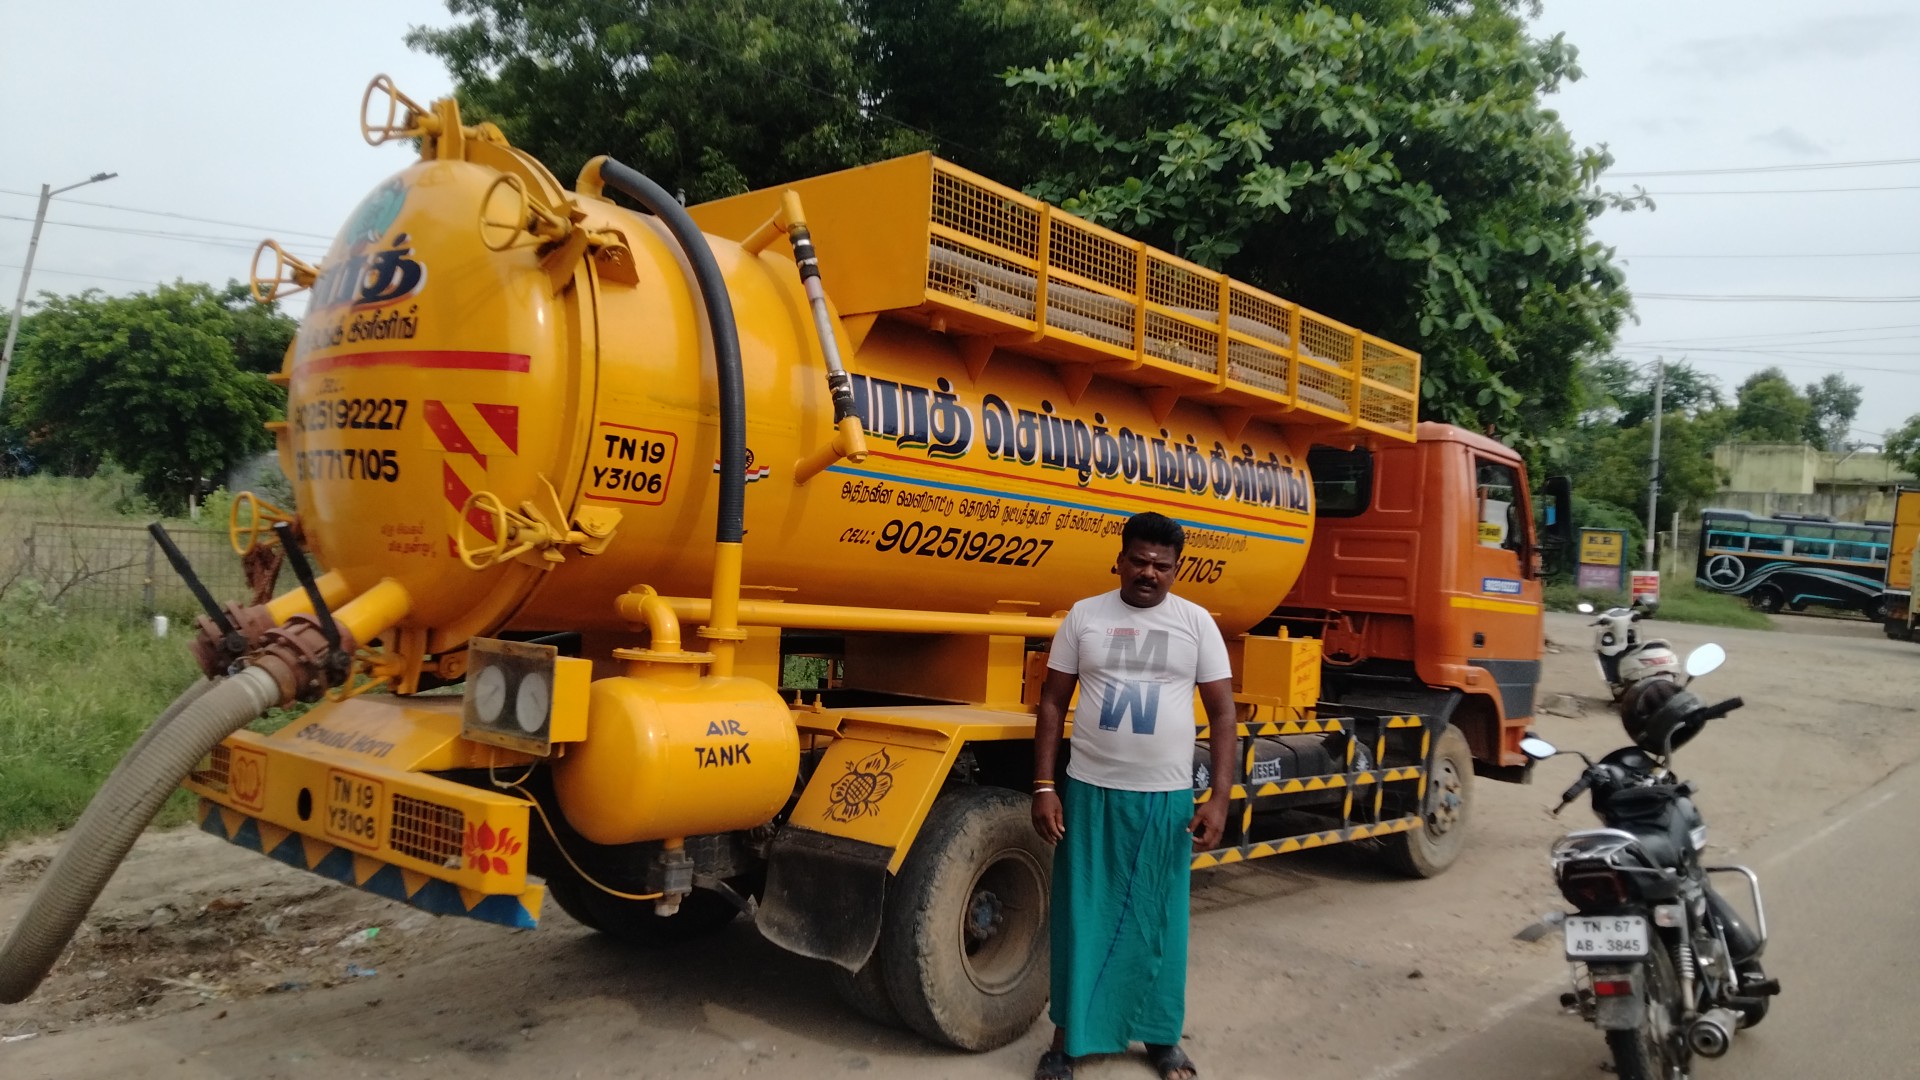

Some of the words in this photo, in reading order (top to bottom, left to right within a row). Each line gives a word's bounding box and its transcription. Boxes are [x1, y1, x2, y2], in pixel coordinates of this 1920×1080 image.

[605, 434, 637, 461] TN
[641, 440, 665, 464] 19
[593, 465, 662, 494] Y3106
[875, 519, 1054, 567] 9025192227
[706, 719, 748, 736] AIR
[695, 743, 751, 769] TANK
[1253, 760, 1281, 780] IESEL
[334, 776, 352, 803] TN
[356, 783, 374, 809] 19
[328, 805, 376, 839] Y3106
[1583, 921, 1602, 933] TN
[1614, 921, 1630, 933] 67
[1576, 940, 1594, 952] AB
[1607, 940, 1641, 952] 3845
